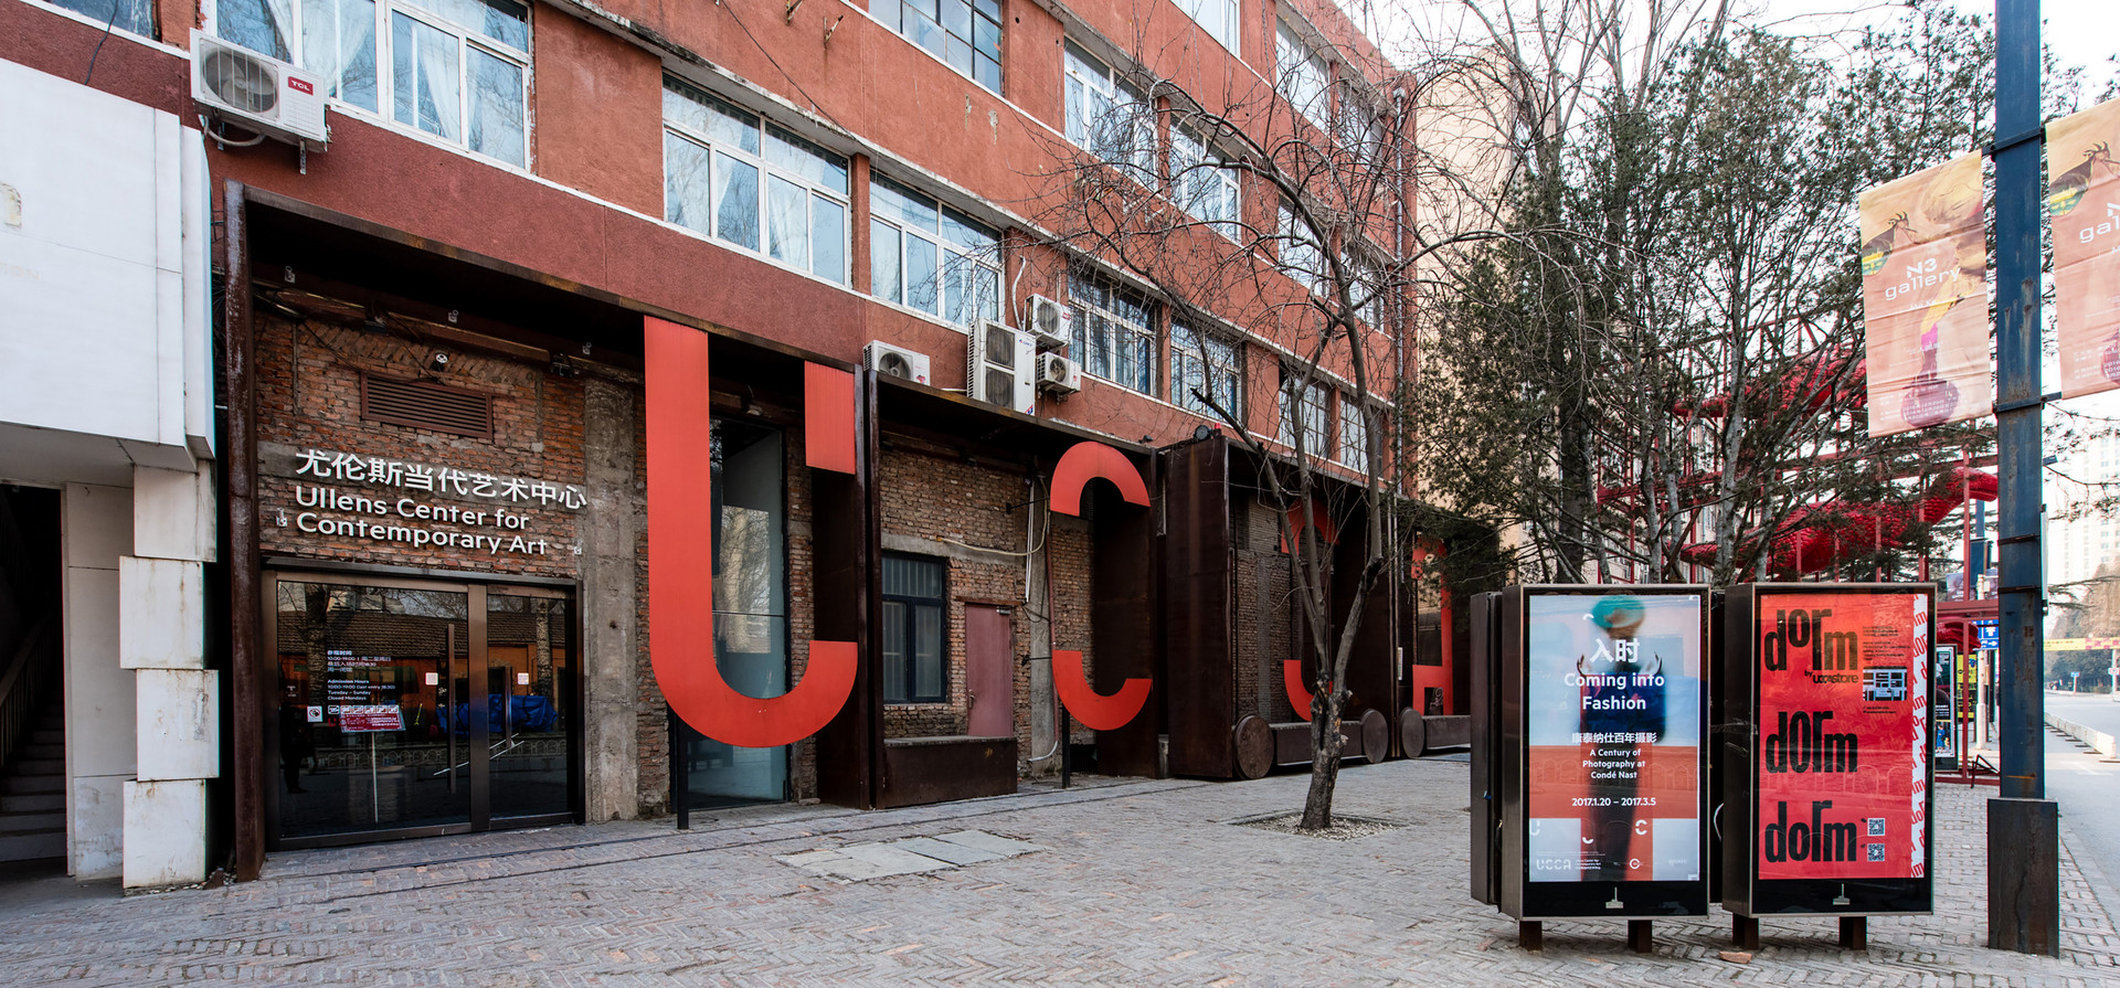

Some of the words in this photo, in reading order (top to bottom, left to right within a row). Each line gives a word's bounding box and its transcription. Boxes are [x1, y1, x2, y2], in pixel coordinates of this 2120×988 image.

[291, 80, 310, 91] TCL
[1906, 258, 1937, 278] N3
[1885, 267, 1960, 300] gallery
[295, 449, 587, 510] 尤伦斯当代艺术中心
[296, 486, 387, 515] Ullens
[397, 499, 486, 526] Center
[495, 509, 529, 530] for
[296, 512, 502, 555] Contemporary
[509, 536, 547, 555] Art
[1764, 609, 1858, 671] dorm
[1590, 638, 1640, 663] 入时
[1564, 672, 1626, 690] Coming
[1632, 672, 1665, 687] into
[1583, 696, 1646, 710] Fashion
[1766, 711, 1858, 773] dorm
[1598, 749, 1630, 757] Century
[1633, 748, 1641, 756] of
[1582, 760, 1635, 769] Photography
[1591, 770, 1617, 779] Condé
[1618, 771, 1638, 779] Nast
[1572, 798, 1611, 806] 2017.1.20
[1621, 798, 1656, 806] 2017.3.5
[1765, 801, 1857, 862] dorm
[1536, 859, 1571, 871] UCCA
